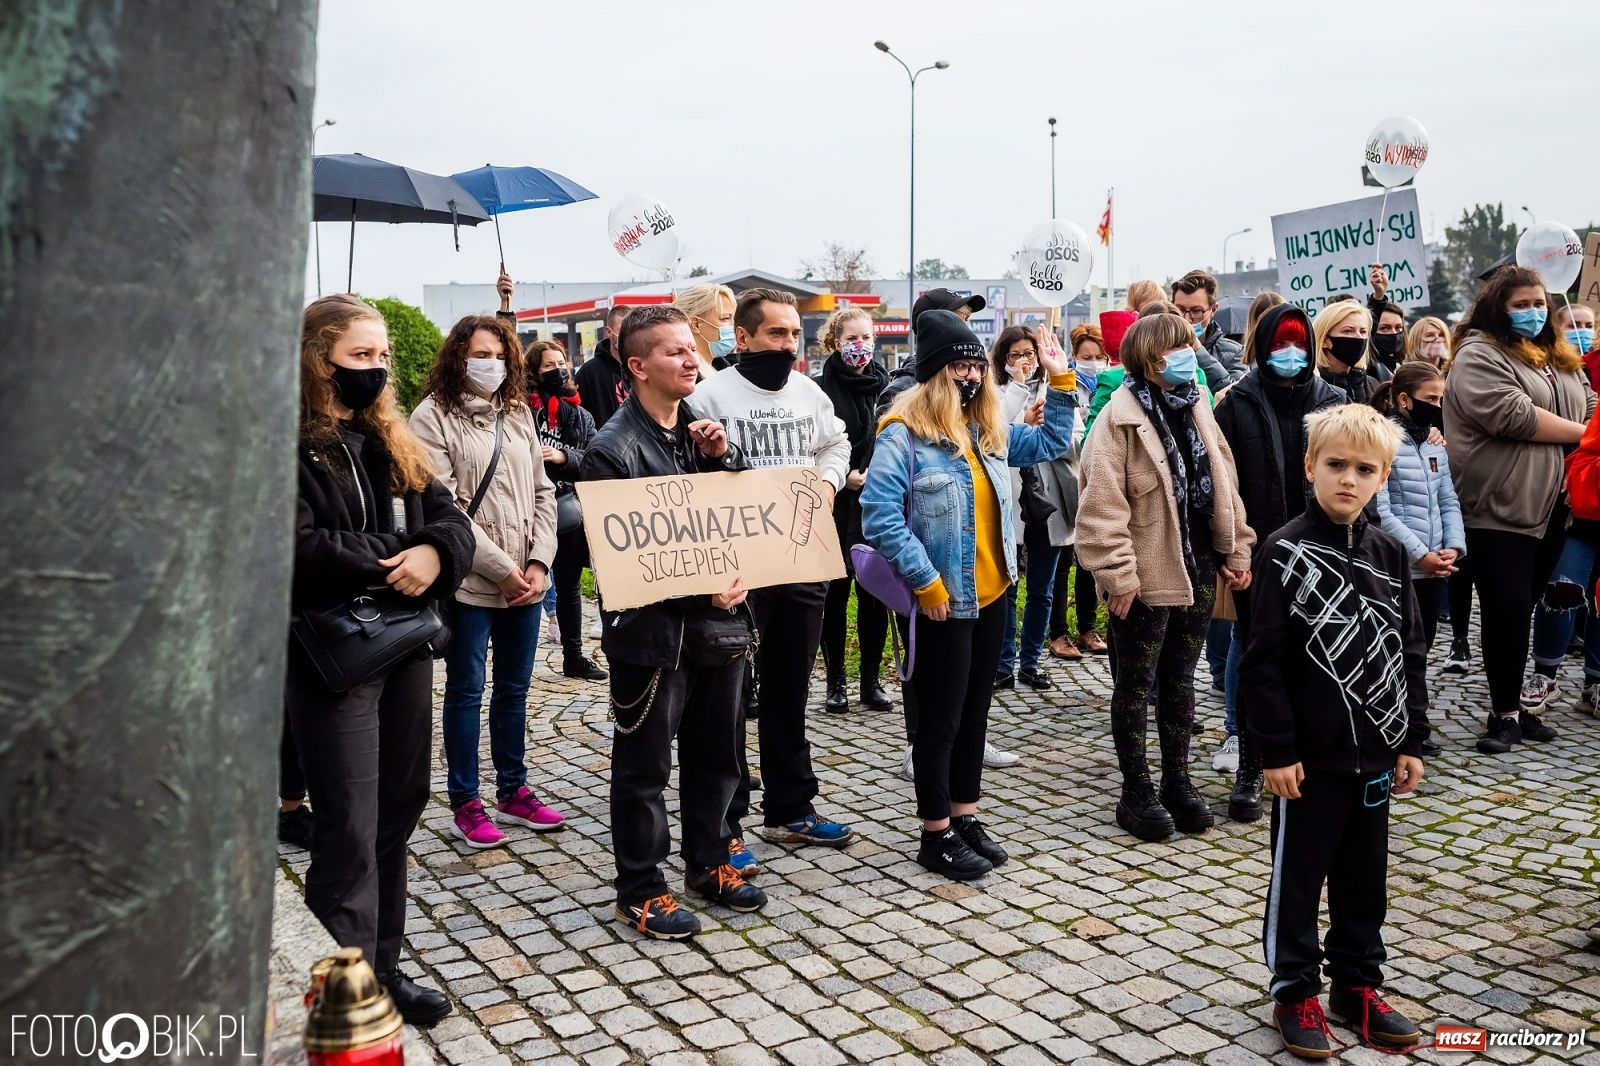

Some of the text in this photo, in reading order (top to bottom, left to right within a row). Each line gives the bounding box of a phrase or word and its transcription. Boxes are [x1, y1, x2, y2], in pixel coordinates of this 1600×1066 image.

[650, 214, 675, 236] 2020
[1566, 243, 1584, 256] 202
[1030, 261, 1063, 281] hello
[1029, 276, 1063, 291] 2020
[1290, 274, 1313, 291] OD
[750, 408, 794, 419] Work Out
[645, 479, 694, 509] STOP
[637, 542, 739, 583] SZCZEPIEŃ
